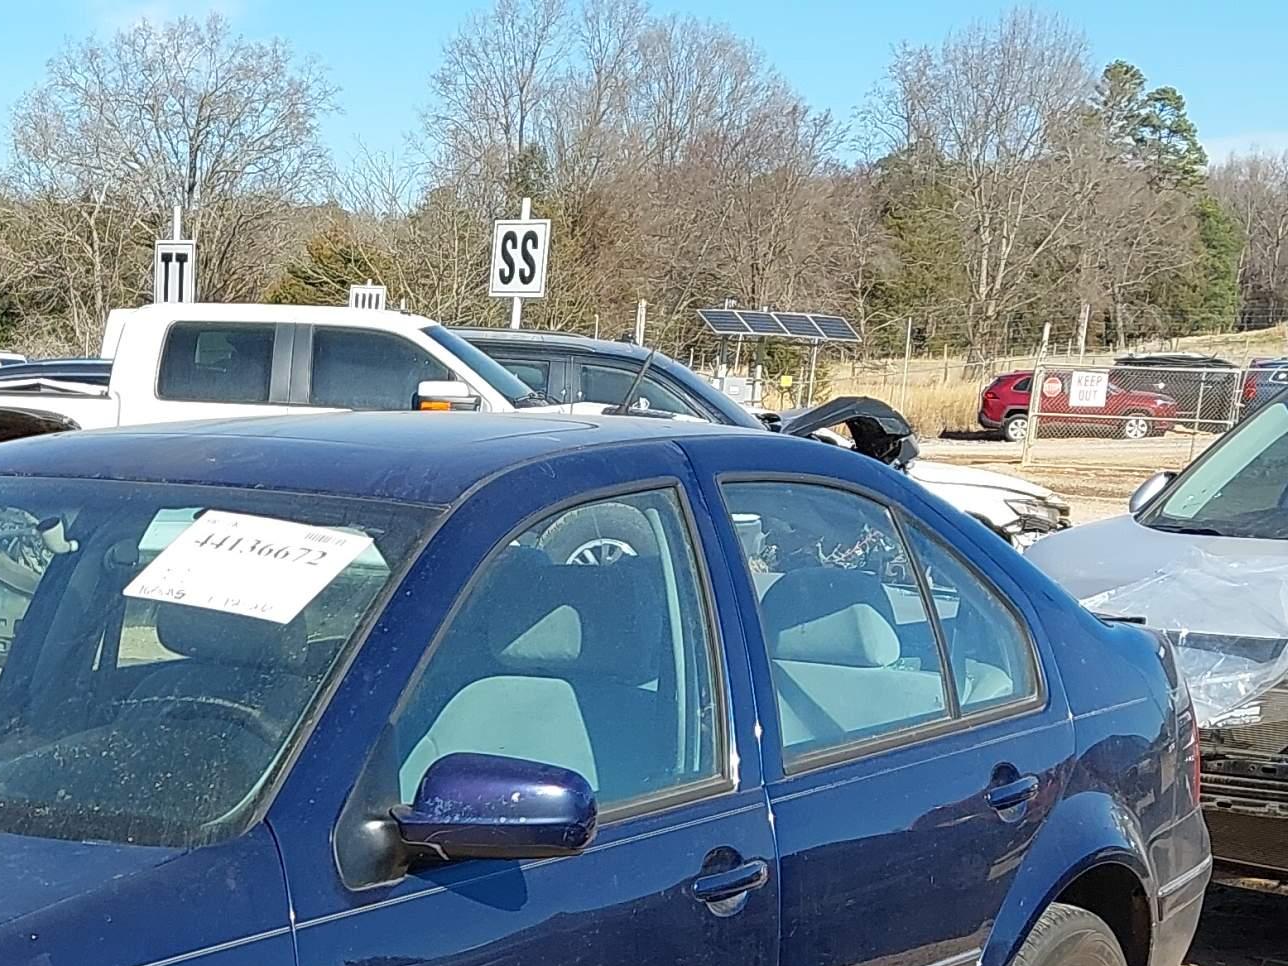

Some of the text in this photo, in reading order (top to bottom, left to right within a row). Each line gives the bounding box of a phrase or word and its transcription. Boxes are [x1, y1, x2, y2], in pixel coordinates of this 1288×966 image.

[499, 230, 539, 285] SS
[1077, 375, 1103, 388] KEEP
[1078, 389, 1098, 402] OUT
[194, 532, 328, 566] 44136672
